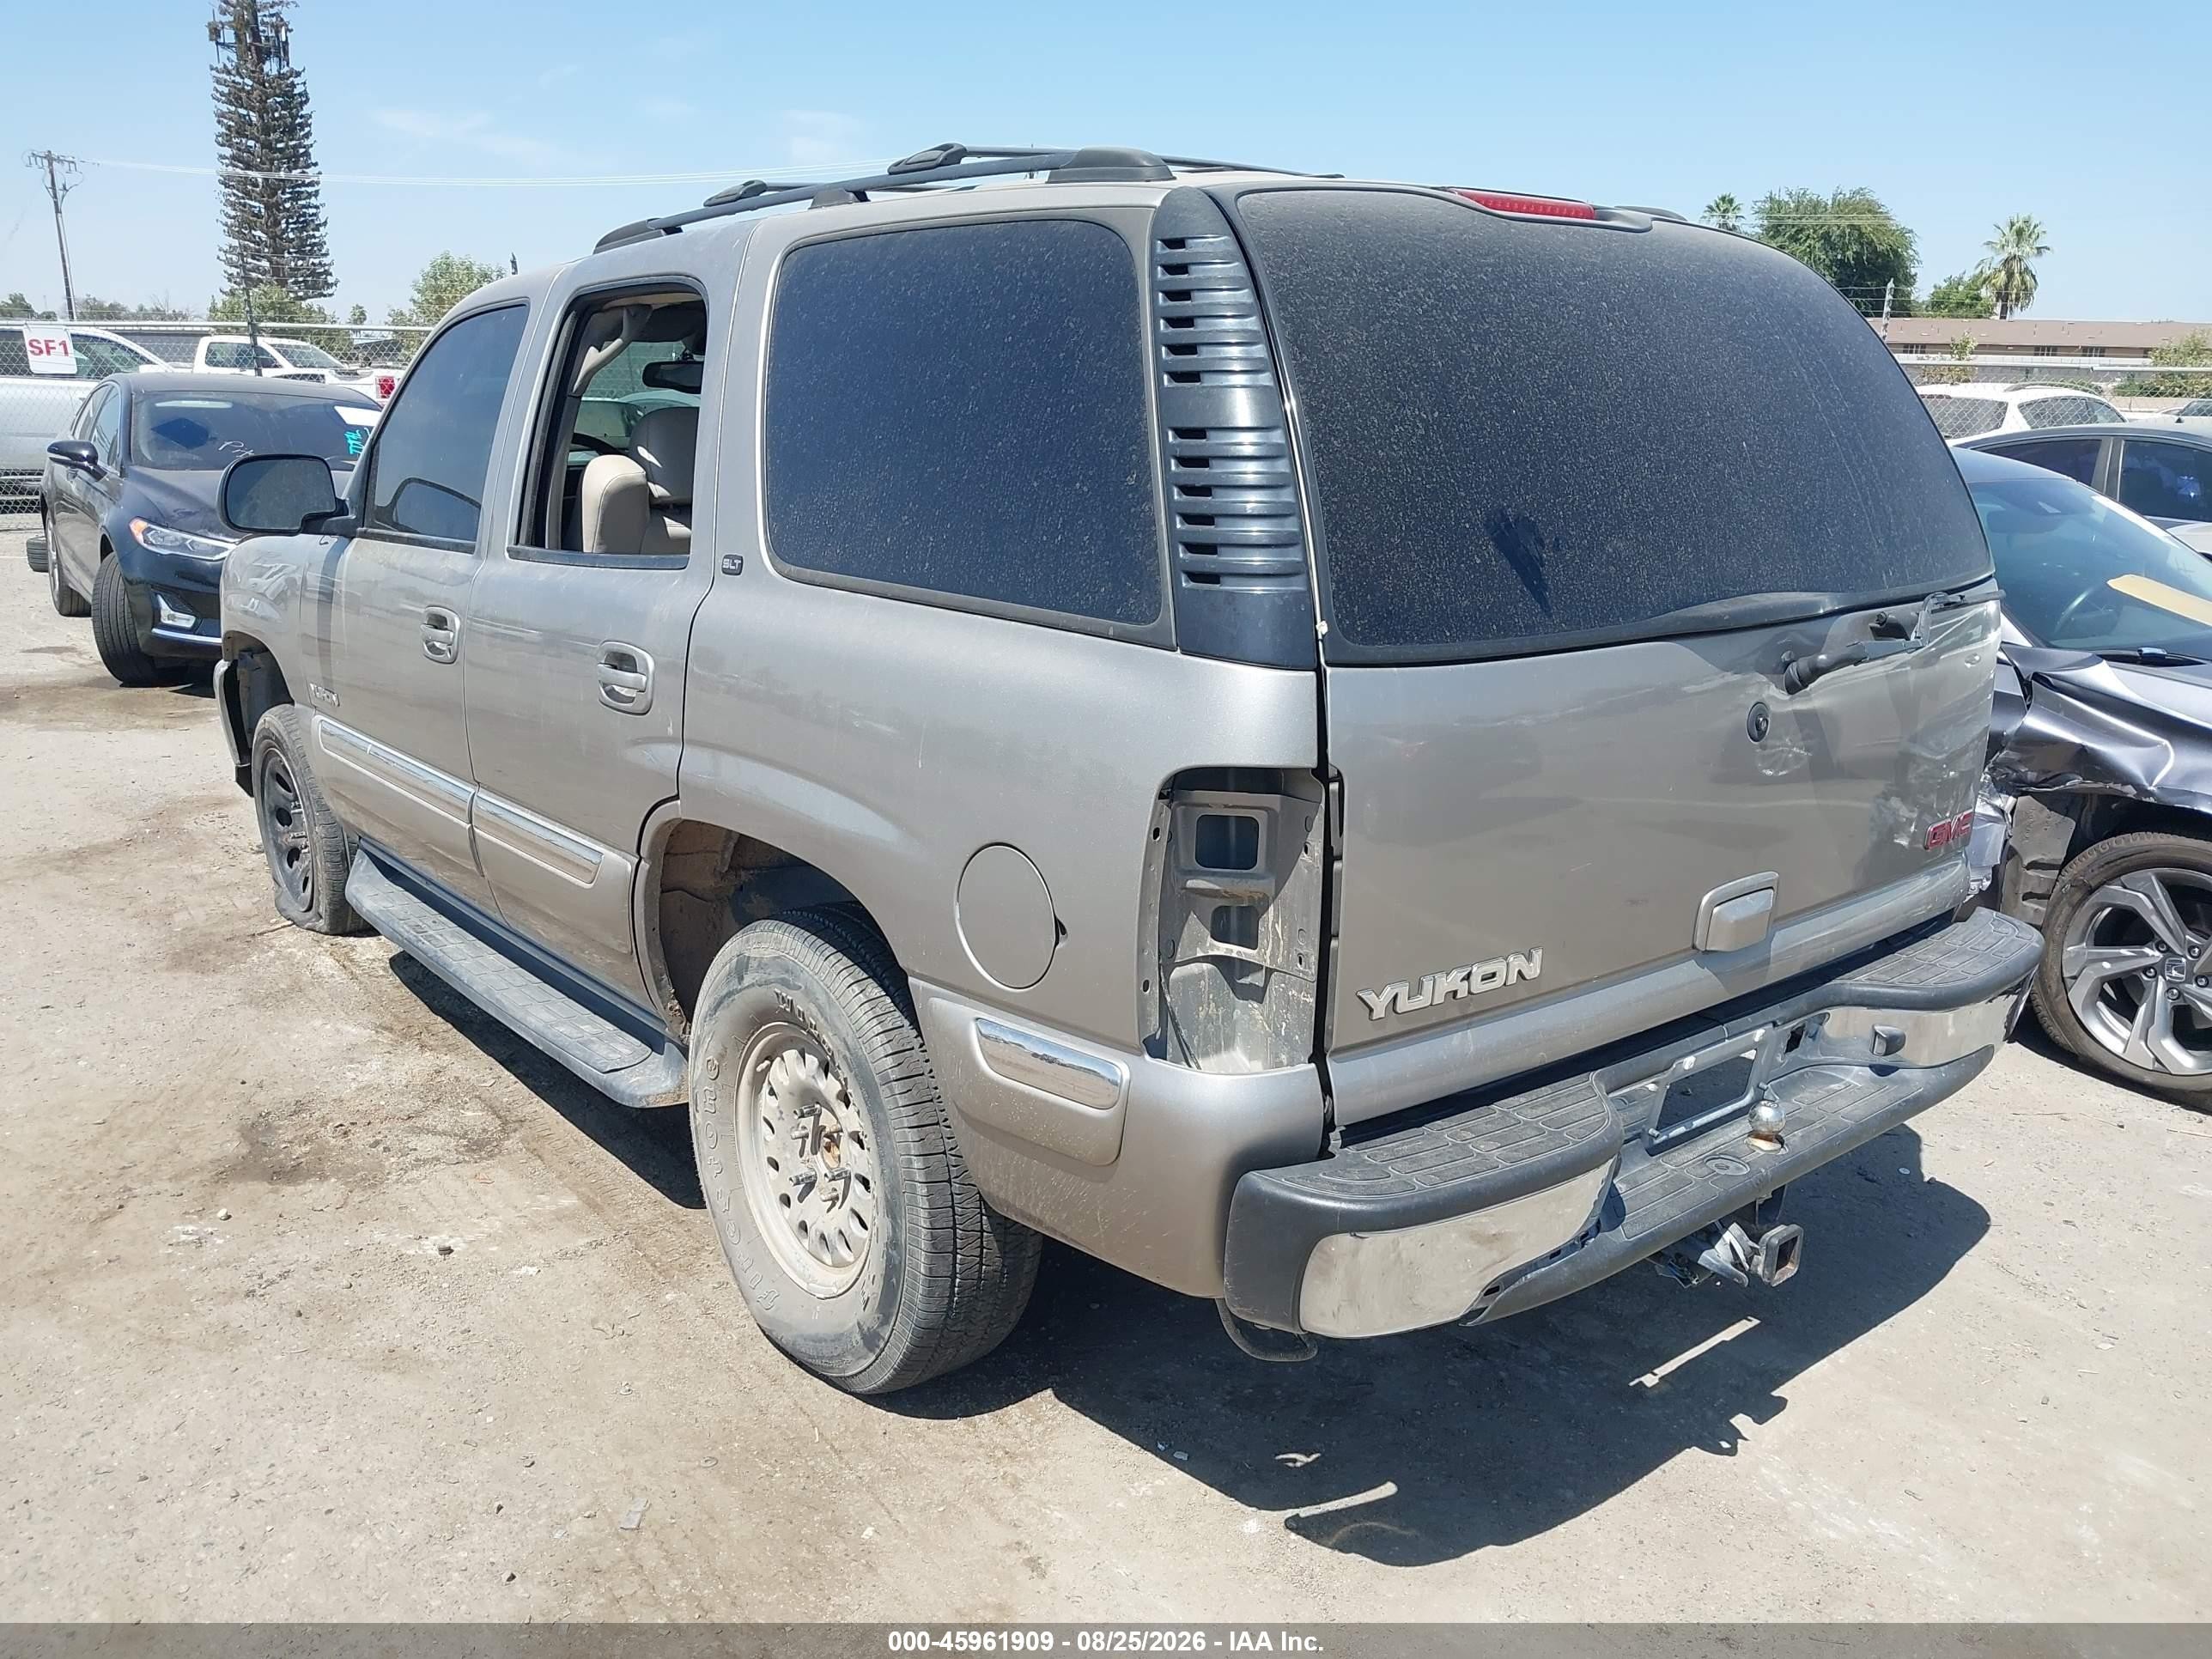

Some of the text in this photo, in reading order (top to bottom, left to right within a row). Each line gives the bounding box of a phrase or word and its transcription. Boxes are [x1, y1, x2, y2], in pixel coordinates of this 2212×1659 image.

[27, 338, 70, 357] SF1
[722, 558, 742, 569] SLT
[1927, 810, 1974, 849] GMC
[1356, 946, 1544, 1021] YUKON
